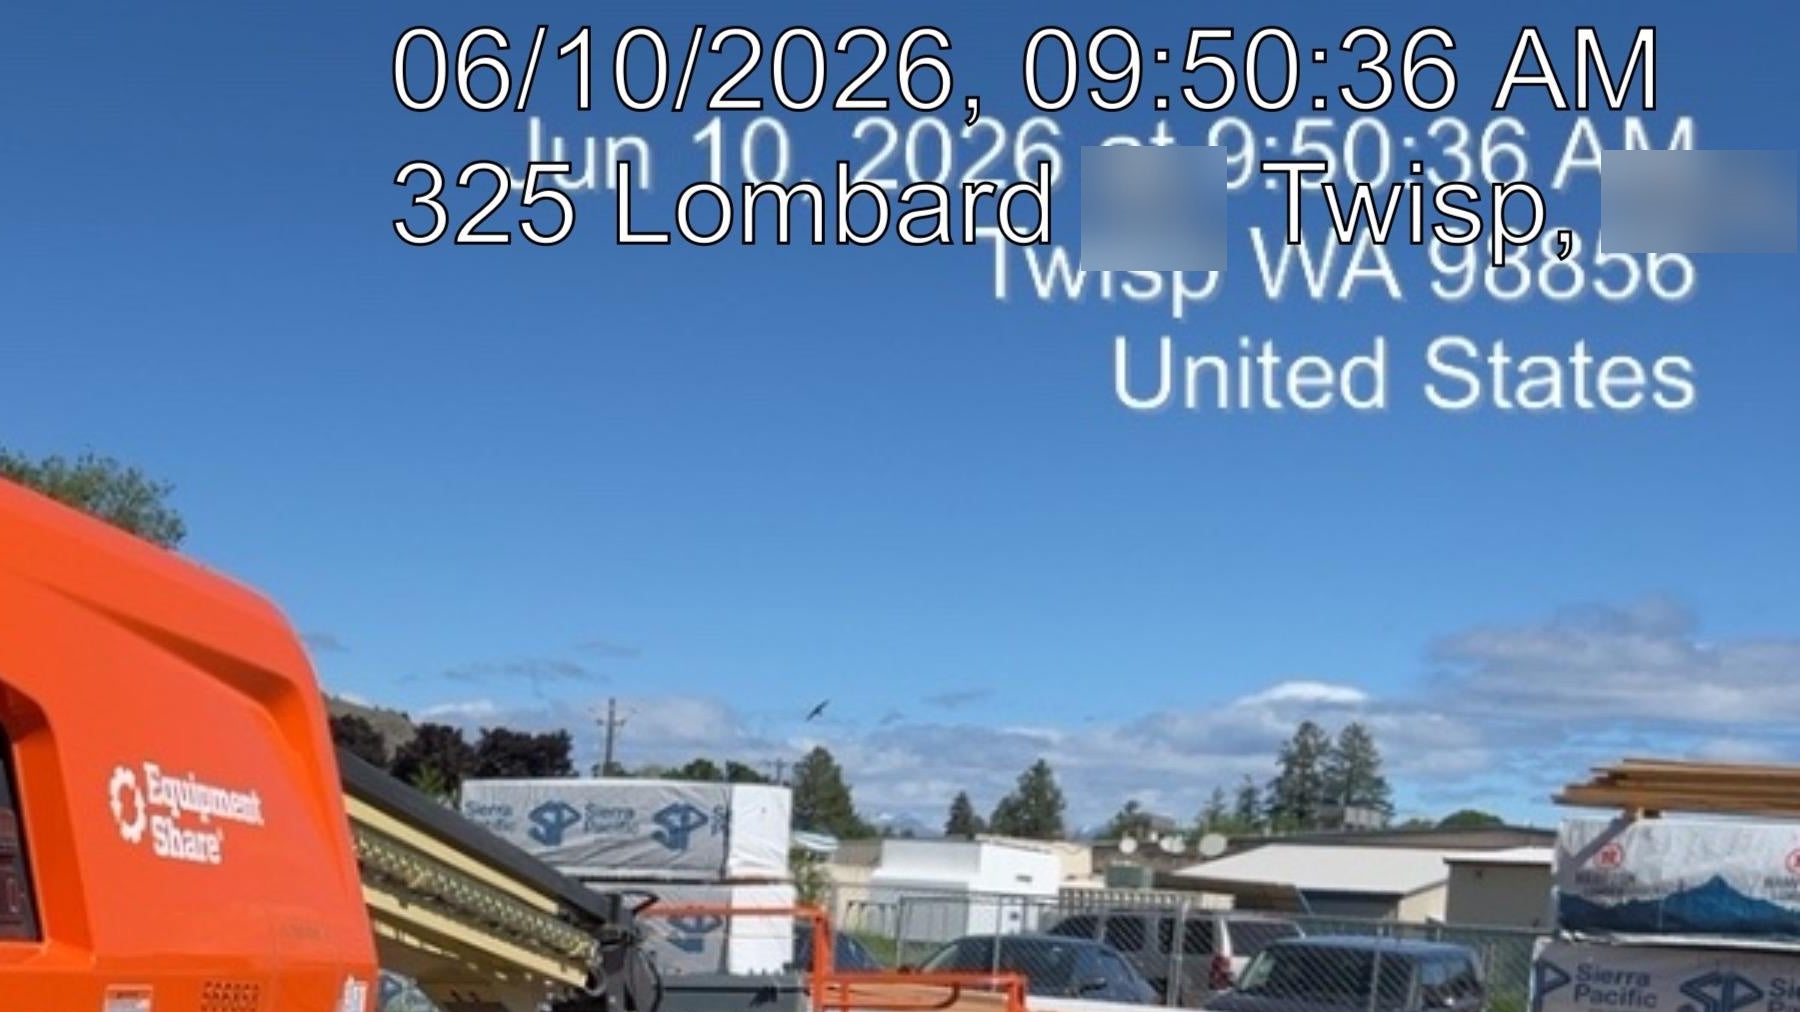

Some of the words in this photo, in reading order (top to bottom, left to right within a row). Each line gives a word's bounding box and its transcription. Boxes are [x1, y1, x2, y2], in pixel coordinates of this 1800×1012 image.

[143, 761, 265, 827] Equipment
[151, 814, 222, 866] Share
[1574, 964, 1650, 989] Sierra
[1574, 983, 1657, 1010] Pacific
